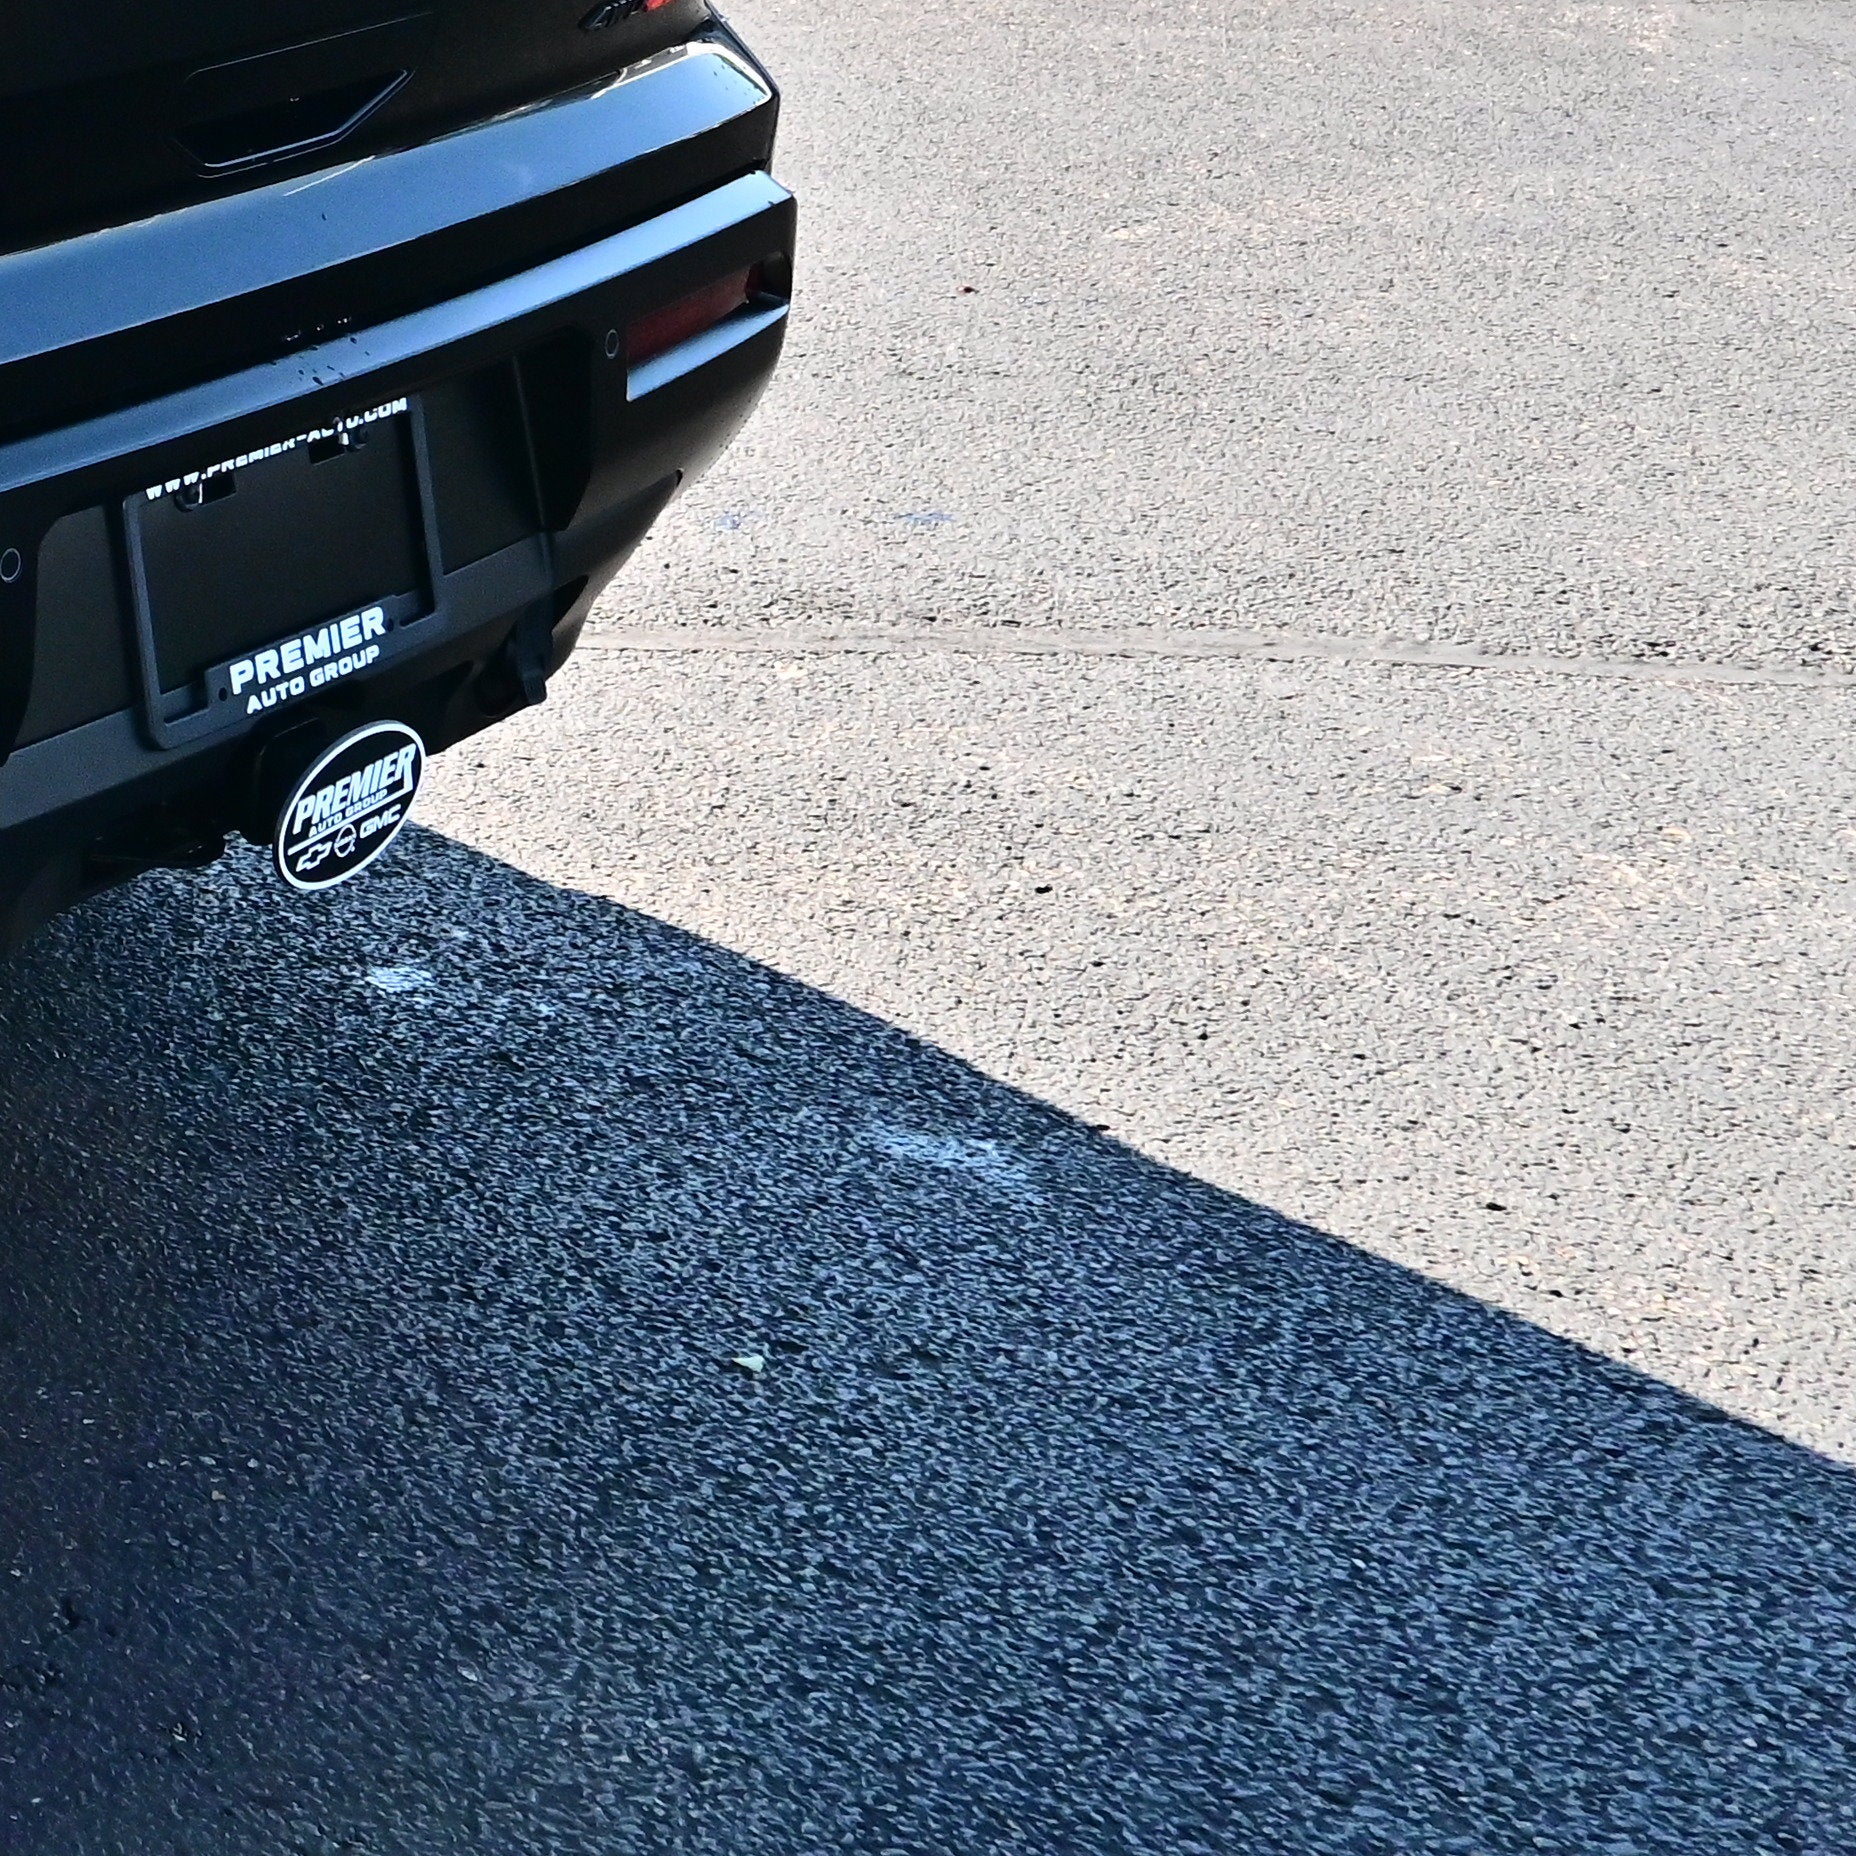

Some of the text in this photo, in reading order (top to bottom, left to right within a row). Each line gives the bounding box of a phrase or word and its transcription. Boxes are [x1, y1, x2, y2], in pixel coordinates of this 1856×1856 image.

[229, 606, 386, 695] PREMIER
[246, 644, 380, 714] AUTO GROUP
[292, 743, 417, 835] PREMIER
[308, 788, 388, 838] AUTO GROUP
[359, 803, 402, 839] GMC
